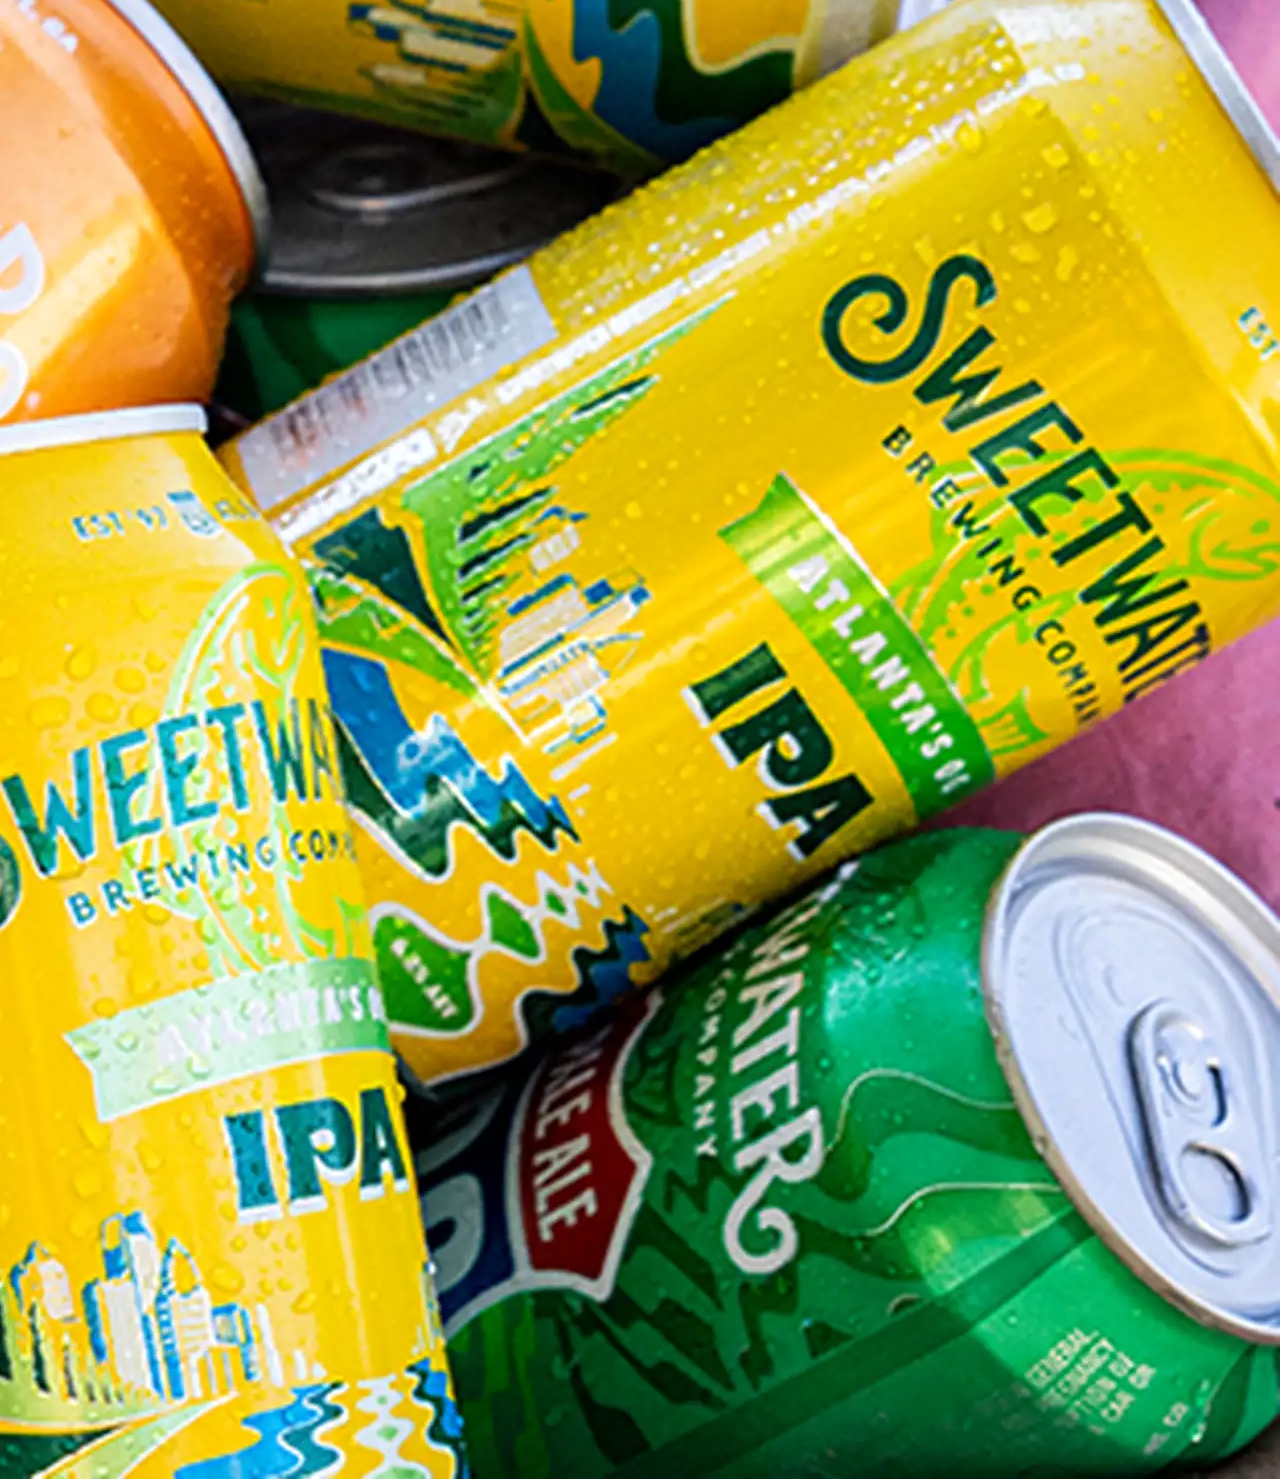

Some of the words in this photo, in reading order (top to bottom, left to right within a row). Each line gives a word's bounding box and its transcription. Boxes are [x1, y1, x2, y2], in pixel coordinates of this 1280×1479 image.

[71, 509, 125, 544] EST
[881, 423, 1044, 614] BREWING
[785, 548, 954, 762] ATLANTA'S
[687, 639, 876, 862] IPA
[66, 831, 277, 930] BREWING
[220, 1085, 412, 1226] IPA
[532, 1133, 598, 1243] ALE
